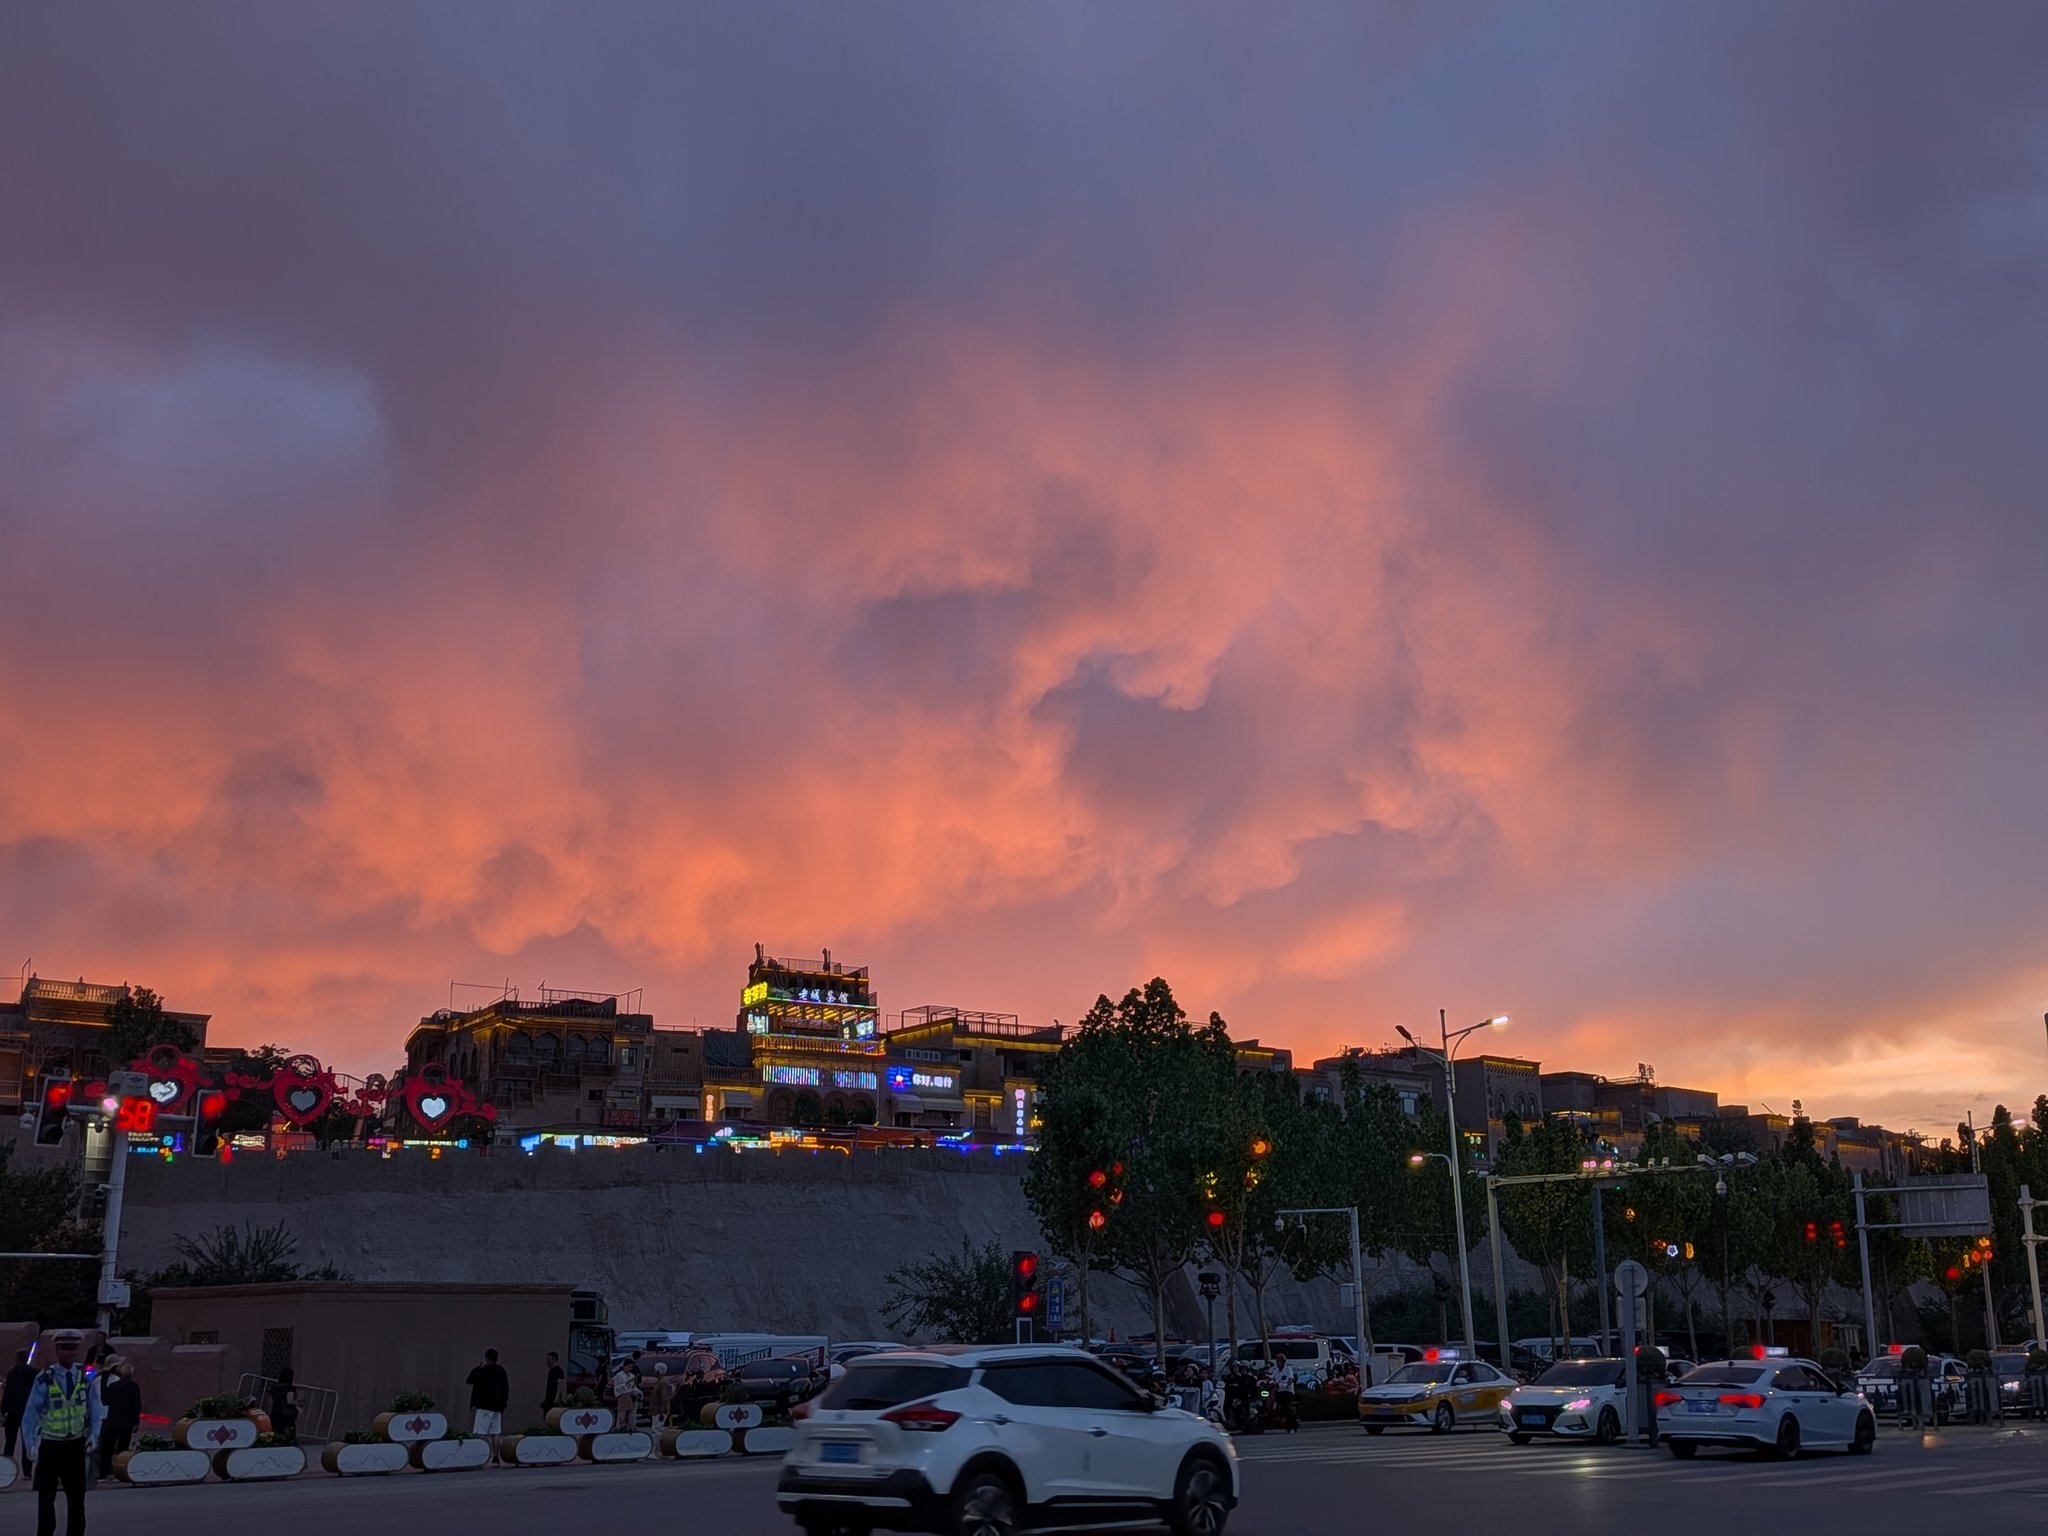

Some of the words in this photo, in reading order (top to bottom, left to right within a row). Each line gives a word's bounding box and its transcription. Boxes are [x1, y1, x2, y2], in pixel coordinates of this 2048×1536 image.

[798, 987, 850, 1004] 老城茶馆
[118, 1098, 153, 1130] 58
